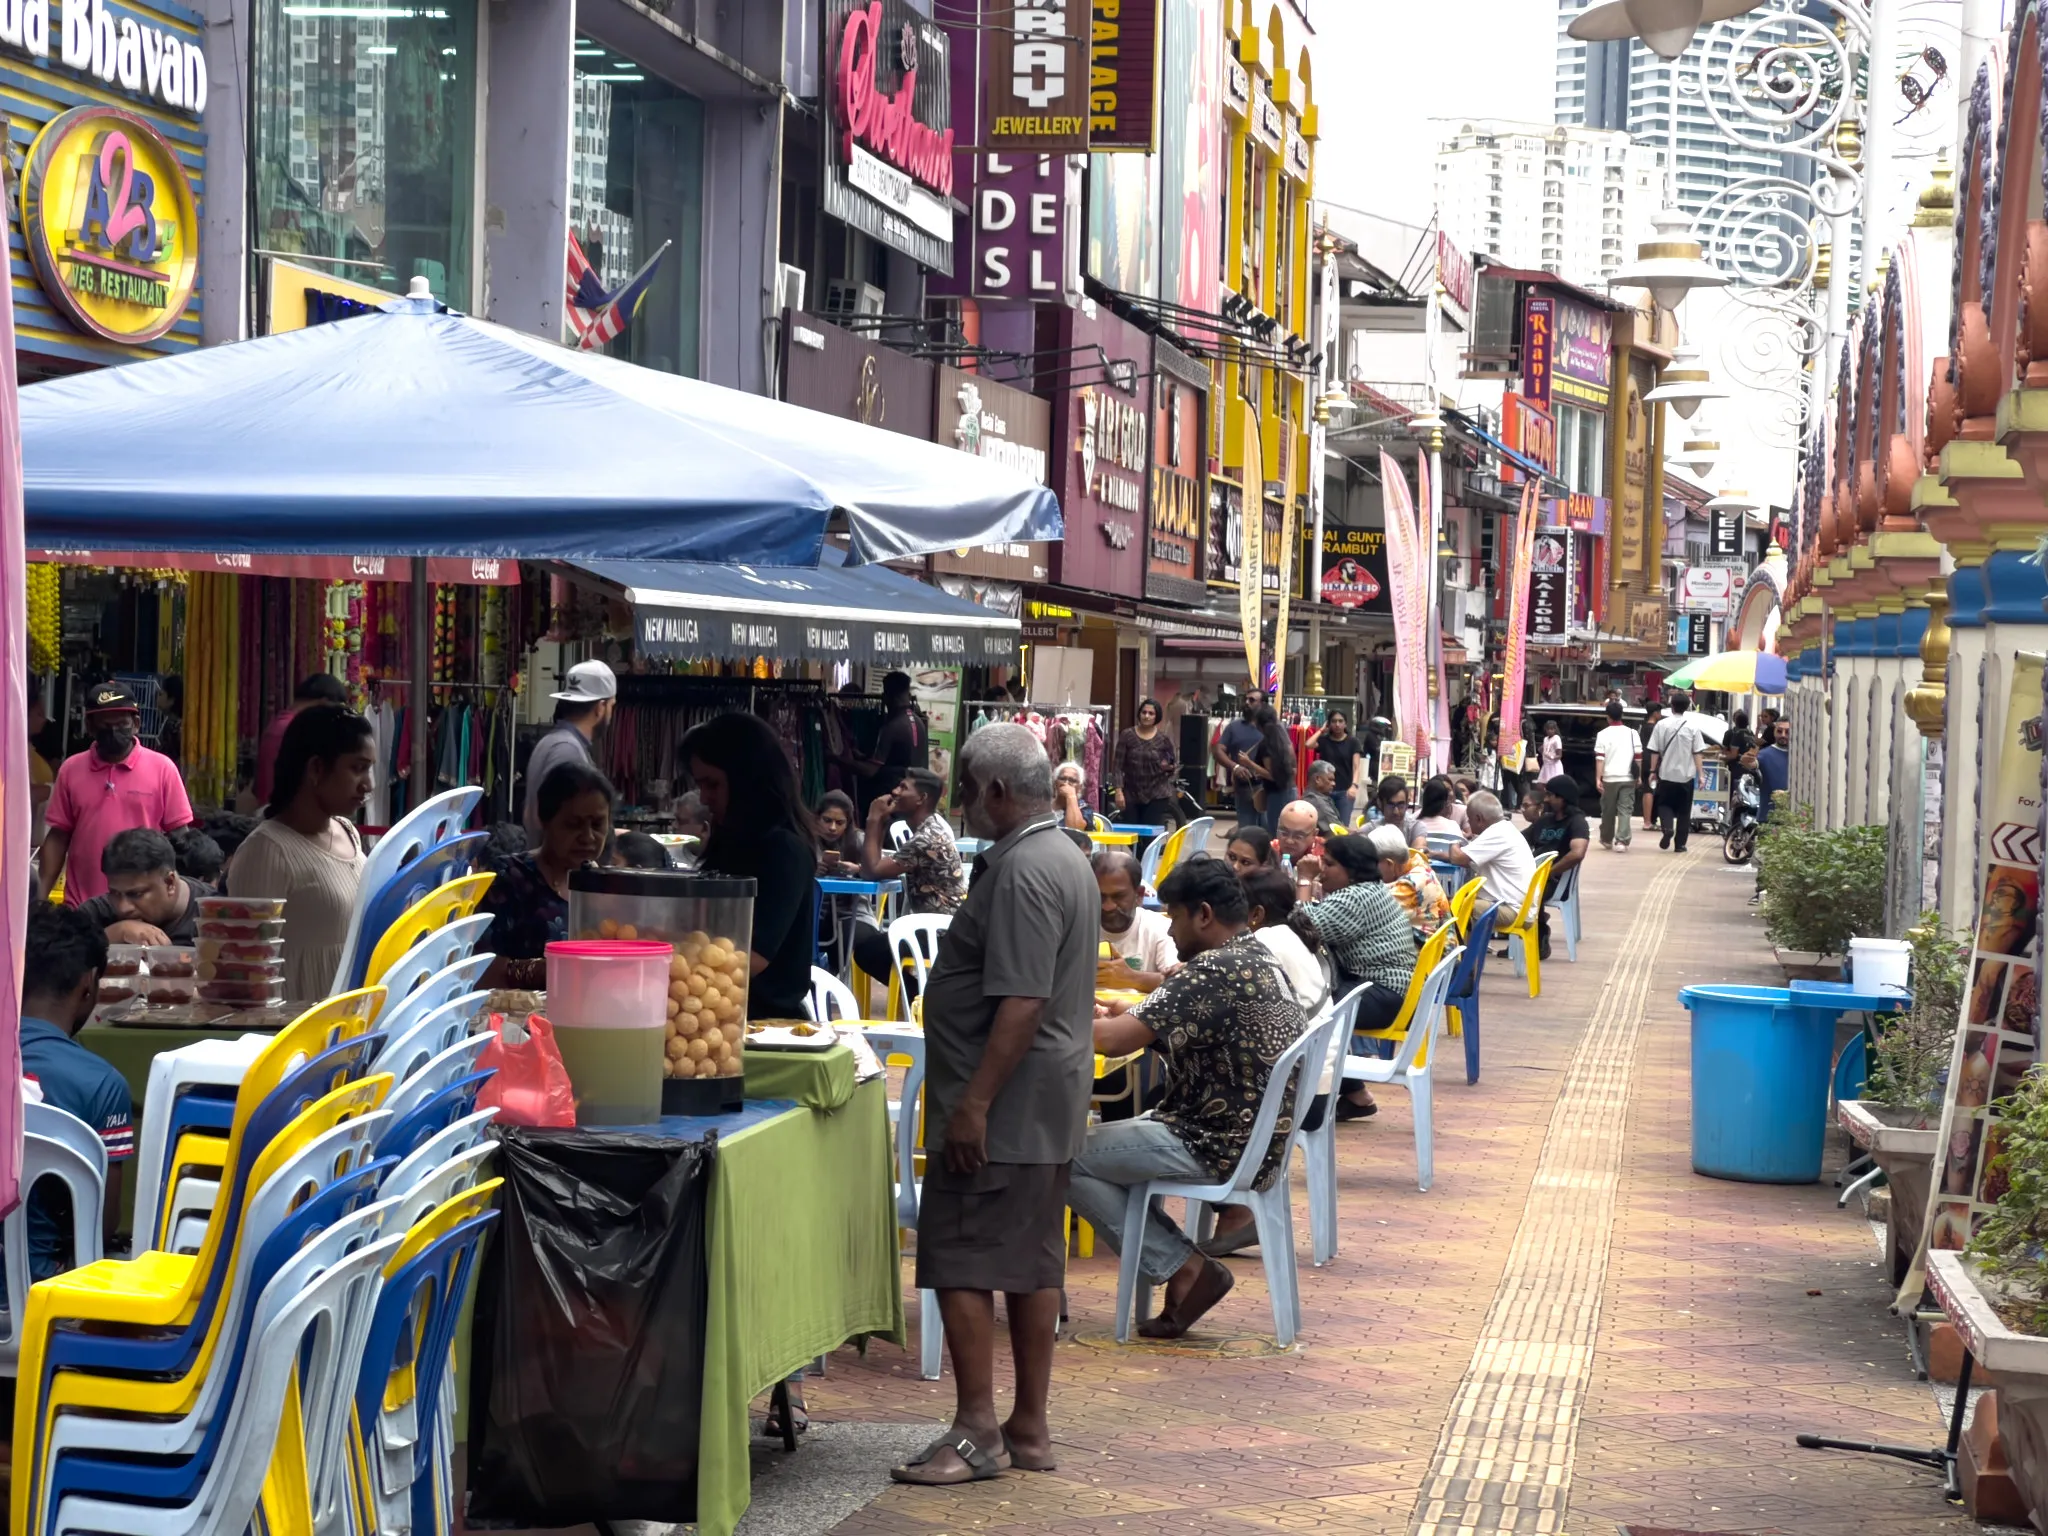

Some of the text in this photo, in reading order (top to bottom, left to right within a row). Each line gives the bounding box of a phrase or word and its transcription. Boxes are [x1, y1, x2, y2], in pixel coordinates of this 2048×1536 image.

[61, 0, 208, 113] Bhavan
[1013, 0, 1066, 107] BAY
[1090, 0, 1120, 131] PALACE
[992, 116, 1083, 136] JEWELLERY
[78, 130, 157, 262] A2B
[71, 263, 170, 308] VEG. RESTAURANT
[1528, 313, 1549, 395] Raani
[1121, 403, 1147, 473] GOLD
[1303, 529, 1338, 541] KEAI
[1323, 543, 1379, 555] RAMBUT
[1535, 574, 1554, 632] TAILORS
[645, 618, 699, 643] NEW MALLIGA
[731, 622, 778, 648] NEW MALLIGA
[807, 628, 849, 650] NEW MALLIGA
[874, 632, 887, 650] NEW
[1693, 615, 1704, 651] JEEL
[2018, 796, 2035, 808] For
[106, 1113, 127, 1128] YALA
